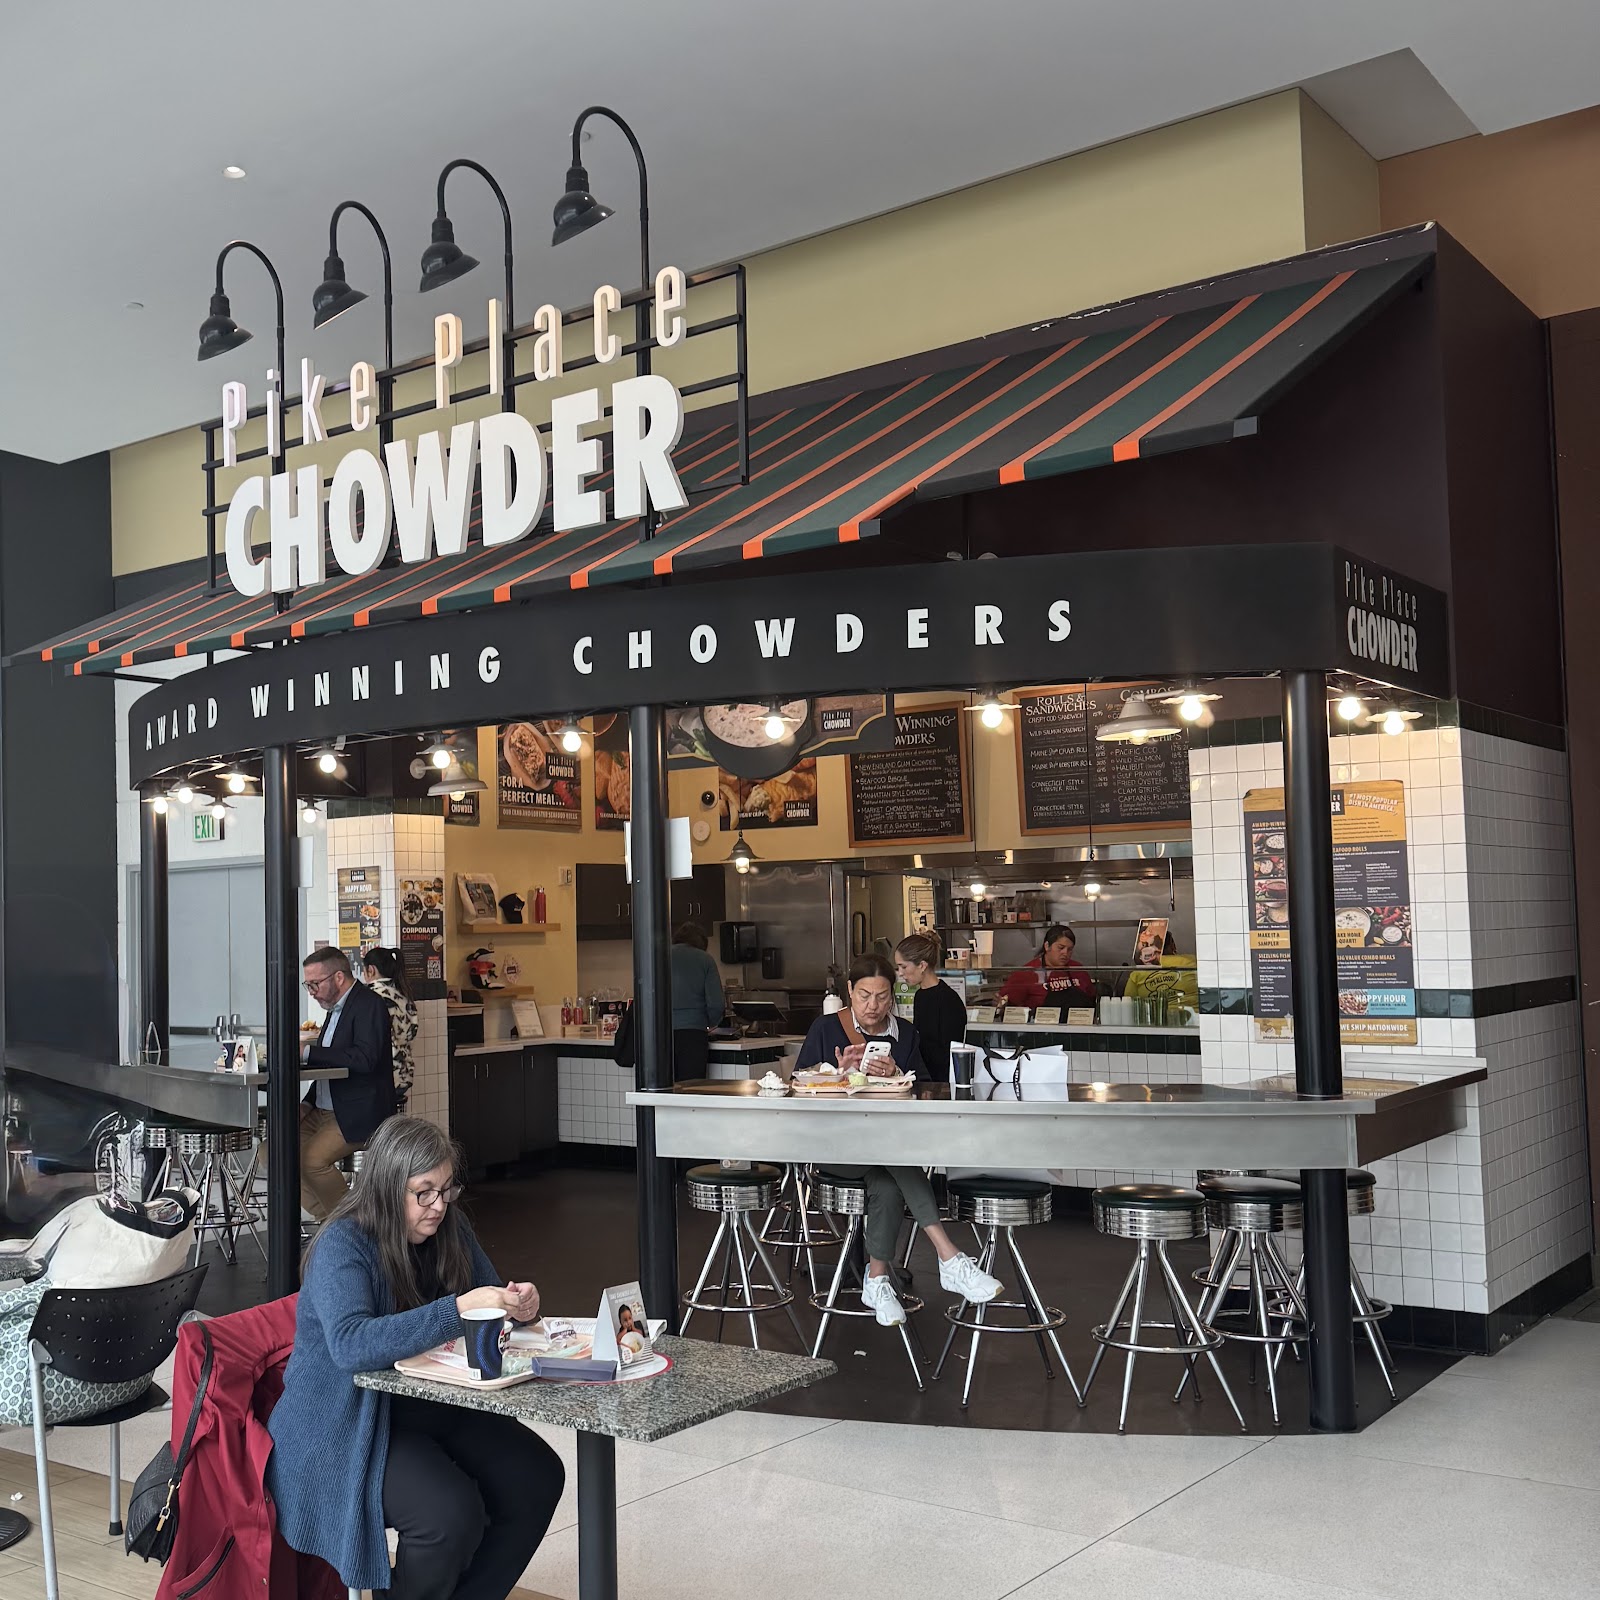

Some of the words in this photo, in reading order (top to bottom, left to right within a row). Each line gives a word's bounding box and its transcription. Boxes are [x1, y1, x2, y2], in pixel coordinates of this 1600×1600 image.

[222, 357, 378, 467] Pike
[435, 265, 687, 409] Place
[225, 375, 689, 597] CHOWDER
[1345, 561, 1375, 606] Pike
[1382, 575, 1417, 622] Place
[1347, 605, 1418, 673] CHOWDER
[145, 697, 218, 751] AWARD
[250, 646, 501, 718] WINNING
[573, 600, 1073, 674] CHOWDERS
[1037, 694, 1074, 706] ROLLS
[1026, 700, 1096, 716] SANDWICHES
[824, 718, 851, 730] CHOWDER
[895, 715, 956, 732] WINNING
[895, 732, 936, 745] WDERS
[1115, 748, 1141, 756] PACIFIC
[1134, 755, 1161, 763] SALMON
[548, 765, 574, 778] CHOWDER
[1116, 763, 1144, 771] HALIBUT
[502, 775, 517, 788] FOR
[518, 777, 524, 788] A
[502, 790, 535, 803] PERFECT
[786, 808, 810, 818] CHOWDER
[194, 814, 216, 839] EXIT
[402, 926, 438, 934] CORPORATE
[1355, 994, 1382, 1003] HAPPY
[1383, 994, 1407, 1003] HOUR
[1367, 1024, 1408, 1032] NATIONWIDE
